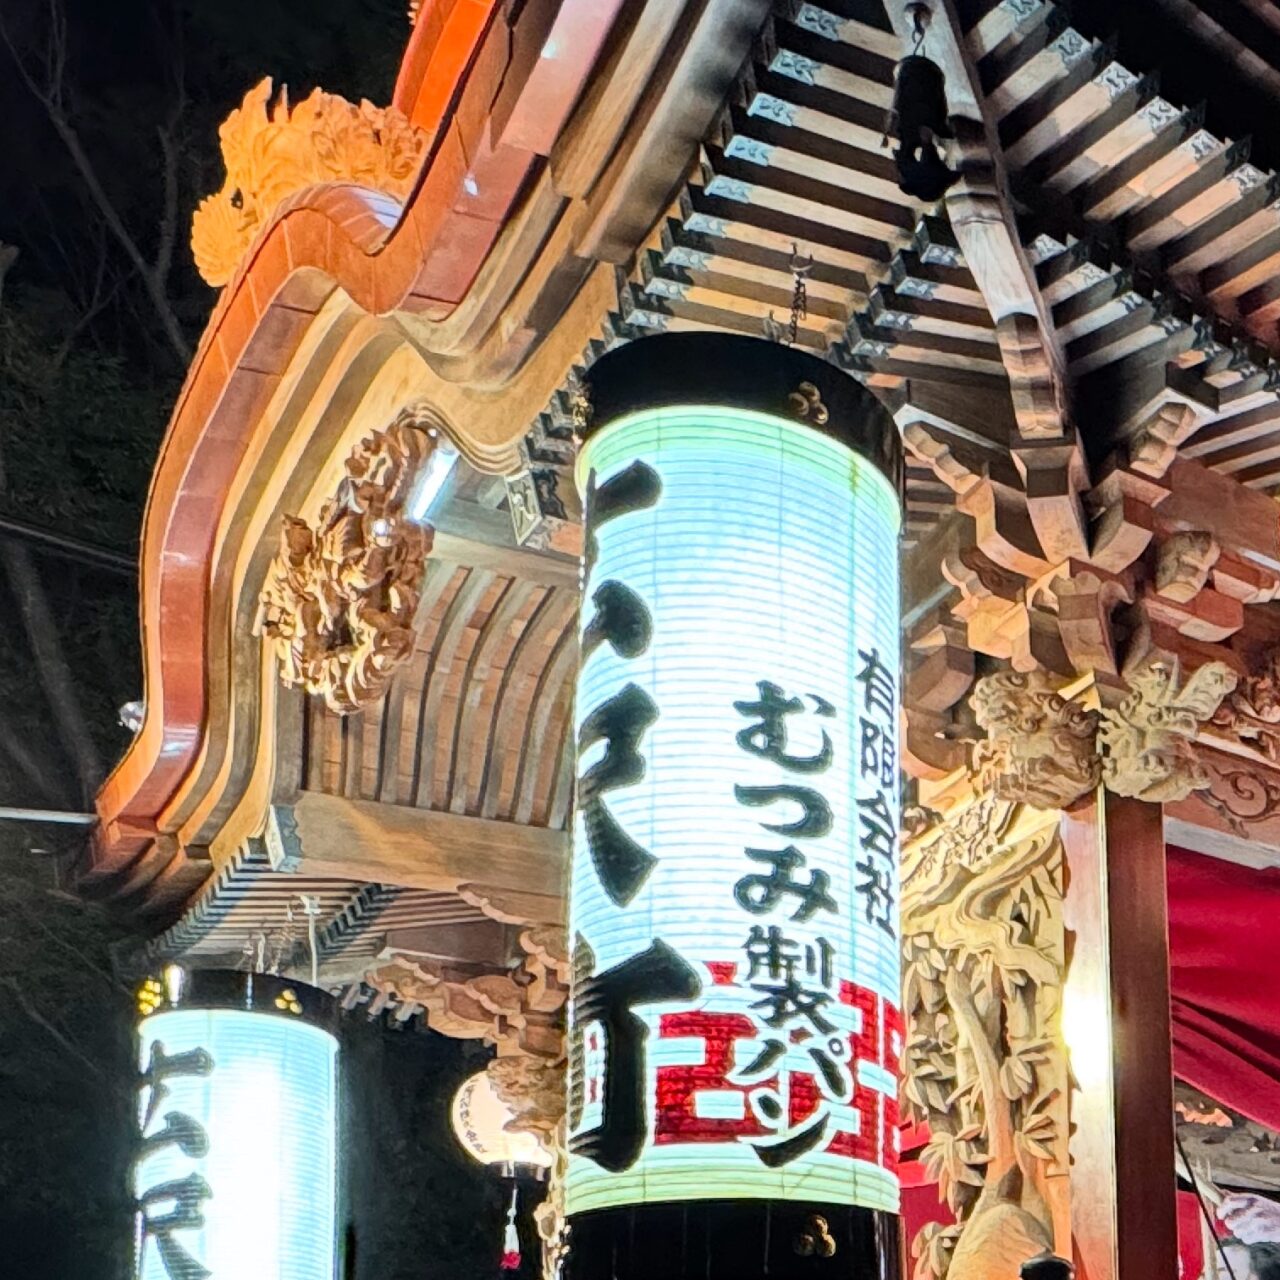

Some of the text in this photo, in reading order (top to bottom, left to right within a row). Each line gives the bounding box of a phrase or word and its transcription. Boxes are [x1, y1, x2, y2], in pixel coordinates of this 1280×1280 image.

[732, 679, 848, 1168] むつみ製パン
